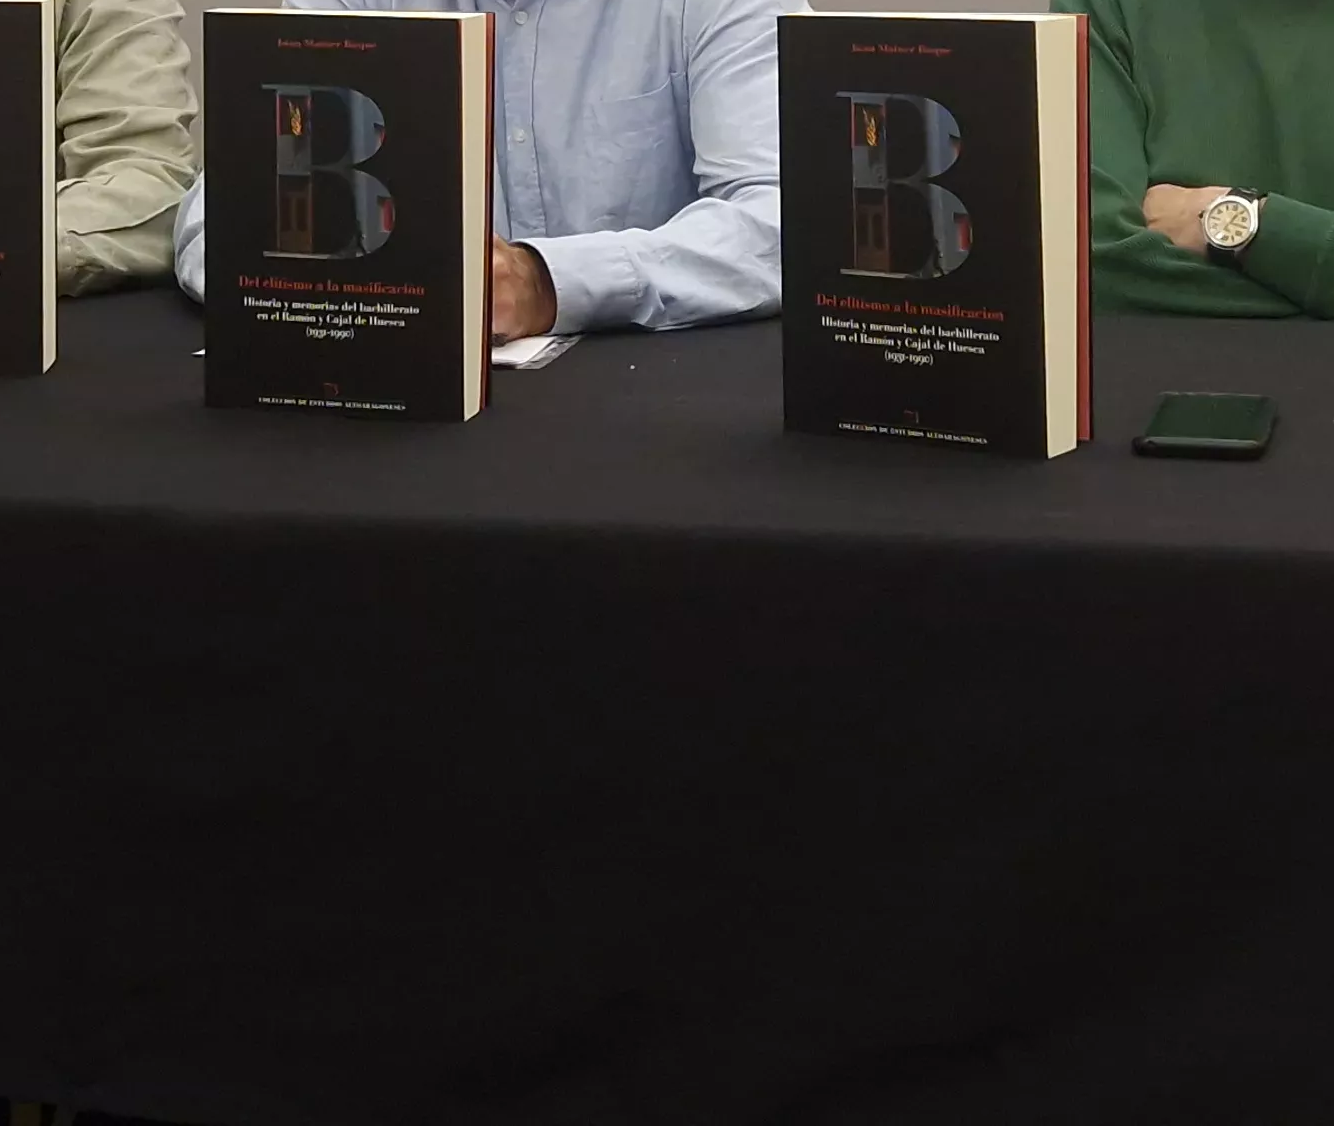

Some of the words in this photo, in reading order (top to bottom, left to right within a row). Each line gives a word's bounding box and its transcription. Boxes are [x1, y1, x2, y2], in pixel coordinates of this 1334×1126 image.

[262, 84, 396, 259] B
[835, 91, 973, 279] B
[239, 276, 260, 288] Del
[327, 279, 339, 292] la
[244, 296, 281, 308] Historia
[283, 302, 289, 311] y
[291, 300, 339, 311] memorias
[341, 302, 357, 312] del
[359, 302, 420, 315] bachillerato
[817, 293, 837, 306] Del
[840, 295, 890, 311] elitismo
[894, 304, 901, 312] a
[905, 301, 917, 314] la
[271, 312, 280, 321] el
[282, 312, 316, 323] Ramón
[318, 317, 324, 326] y
[326, 314, 352, 326] Cajal
[354, 316, 367, 325] de
[369, 316, 405, 327] Huesca
[821, 316, 859, 330] Historia
[862, 323, 868, 333] y
[870, 321, 917, 335] memorias
[920, 325, 935, 336] del
[938, 326, 1000, 341] bachillerato
[835, 334, 846, 342] en
[848, 333, 858, 343] el
[860, 333, 894, 346] Ramón
[897, 340, 903, 349] y
[905, 337, 931, 351] Cajal
[933, 340, 946, 351] de
[948, 342, 985, 354] Huesca
